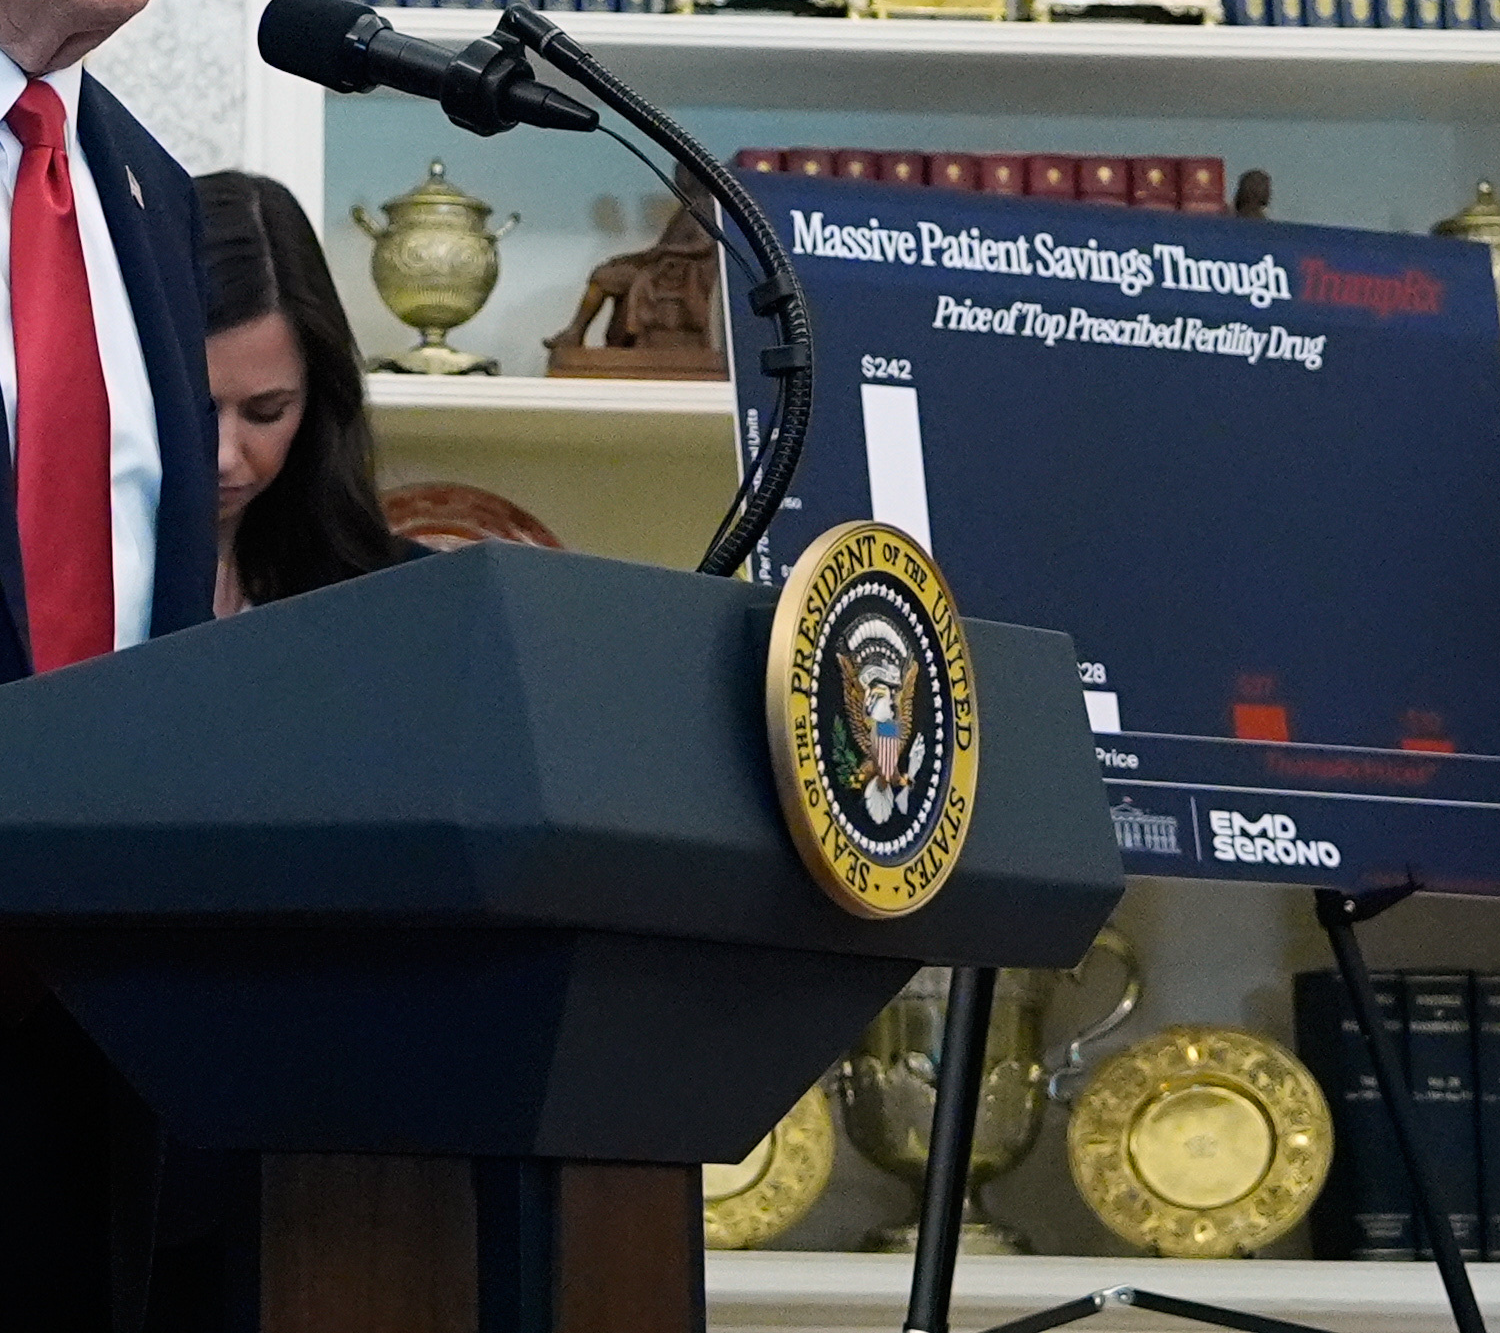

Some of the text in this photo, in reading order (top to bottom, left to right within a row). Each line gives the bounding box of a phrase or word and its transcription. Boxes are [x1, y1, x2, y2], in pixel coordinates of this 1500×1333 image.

[790, 208, 918, 265] Massive
[917, 221, 1033, 275] Patient
[1034, 232, 1154, 297] Savings
[1153, 243, 1292, 309] Through
[932, 295, 1327, 370] Price of Top Prescribed Fertility Drug
[860, 354, 913, 380] $242
[1077, 661, 1108, 684] 28
[791, 534, 973, 900] SEAL OF THE PRESIDENT OF THE UNITED STATES
[1209, 809, 1297, 840] EMD
